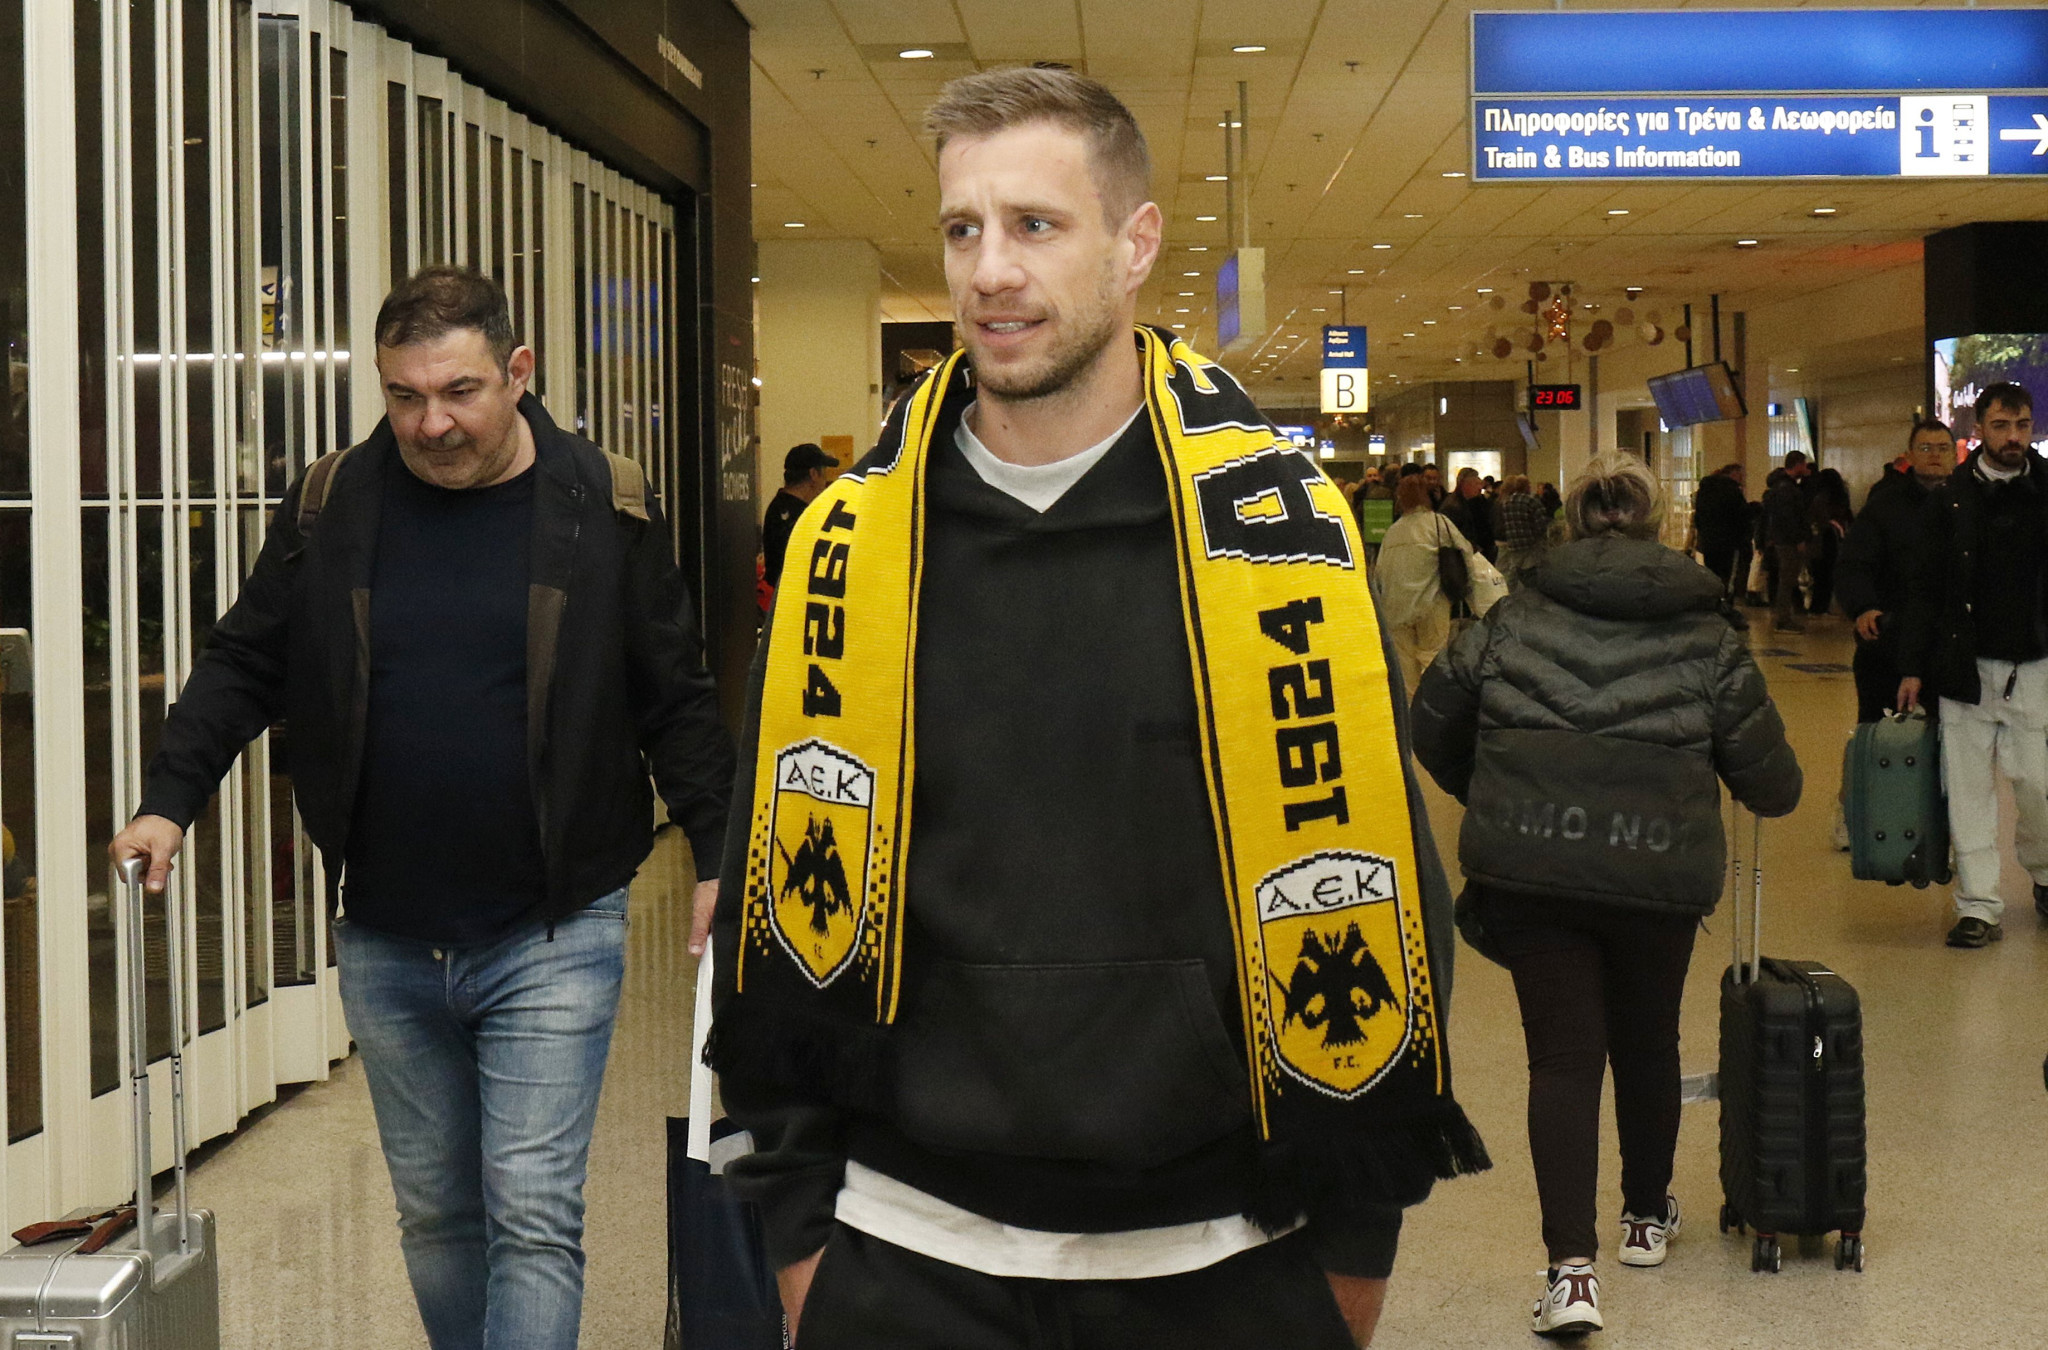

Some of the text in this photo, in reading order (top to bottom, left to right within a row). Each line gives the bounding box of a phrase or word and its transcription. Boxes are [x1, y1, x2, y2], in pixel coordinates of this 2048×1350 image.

[1484, 105, 1896, 136] Πληροφορίες για Τρένα & Λεωφορεία
[1484, 144, 1741, 169] Train & Bus Information
[1336, 373, 1355, 408] B
[802, 499, 856, 718] 1924
[1258, 596, 1351, 832] 1924
